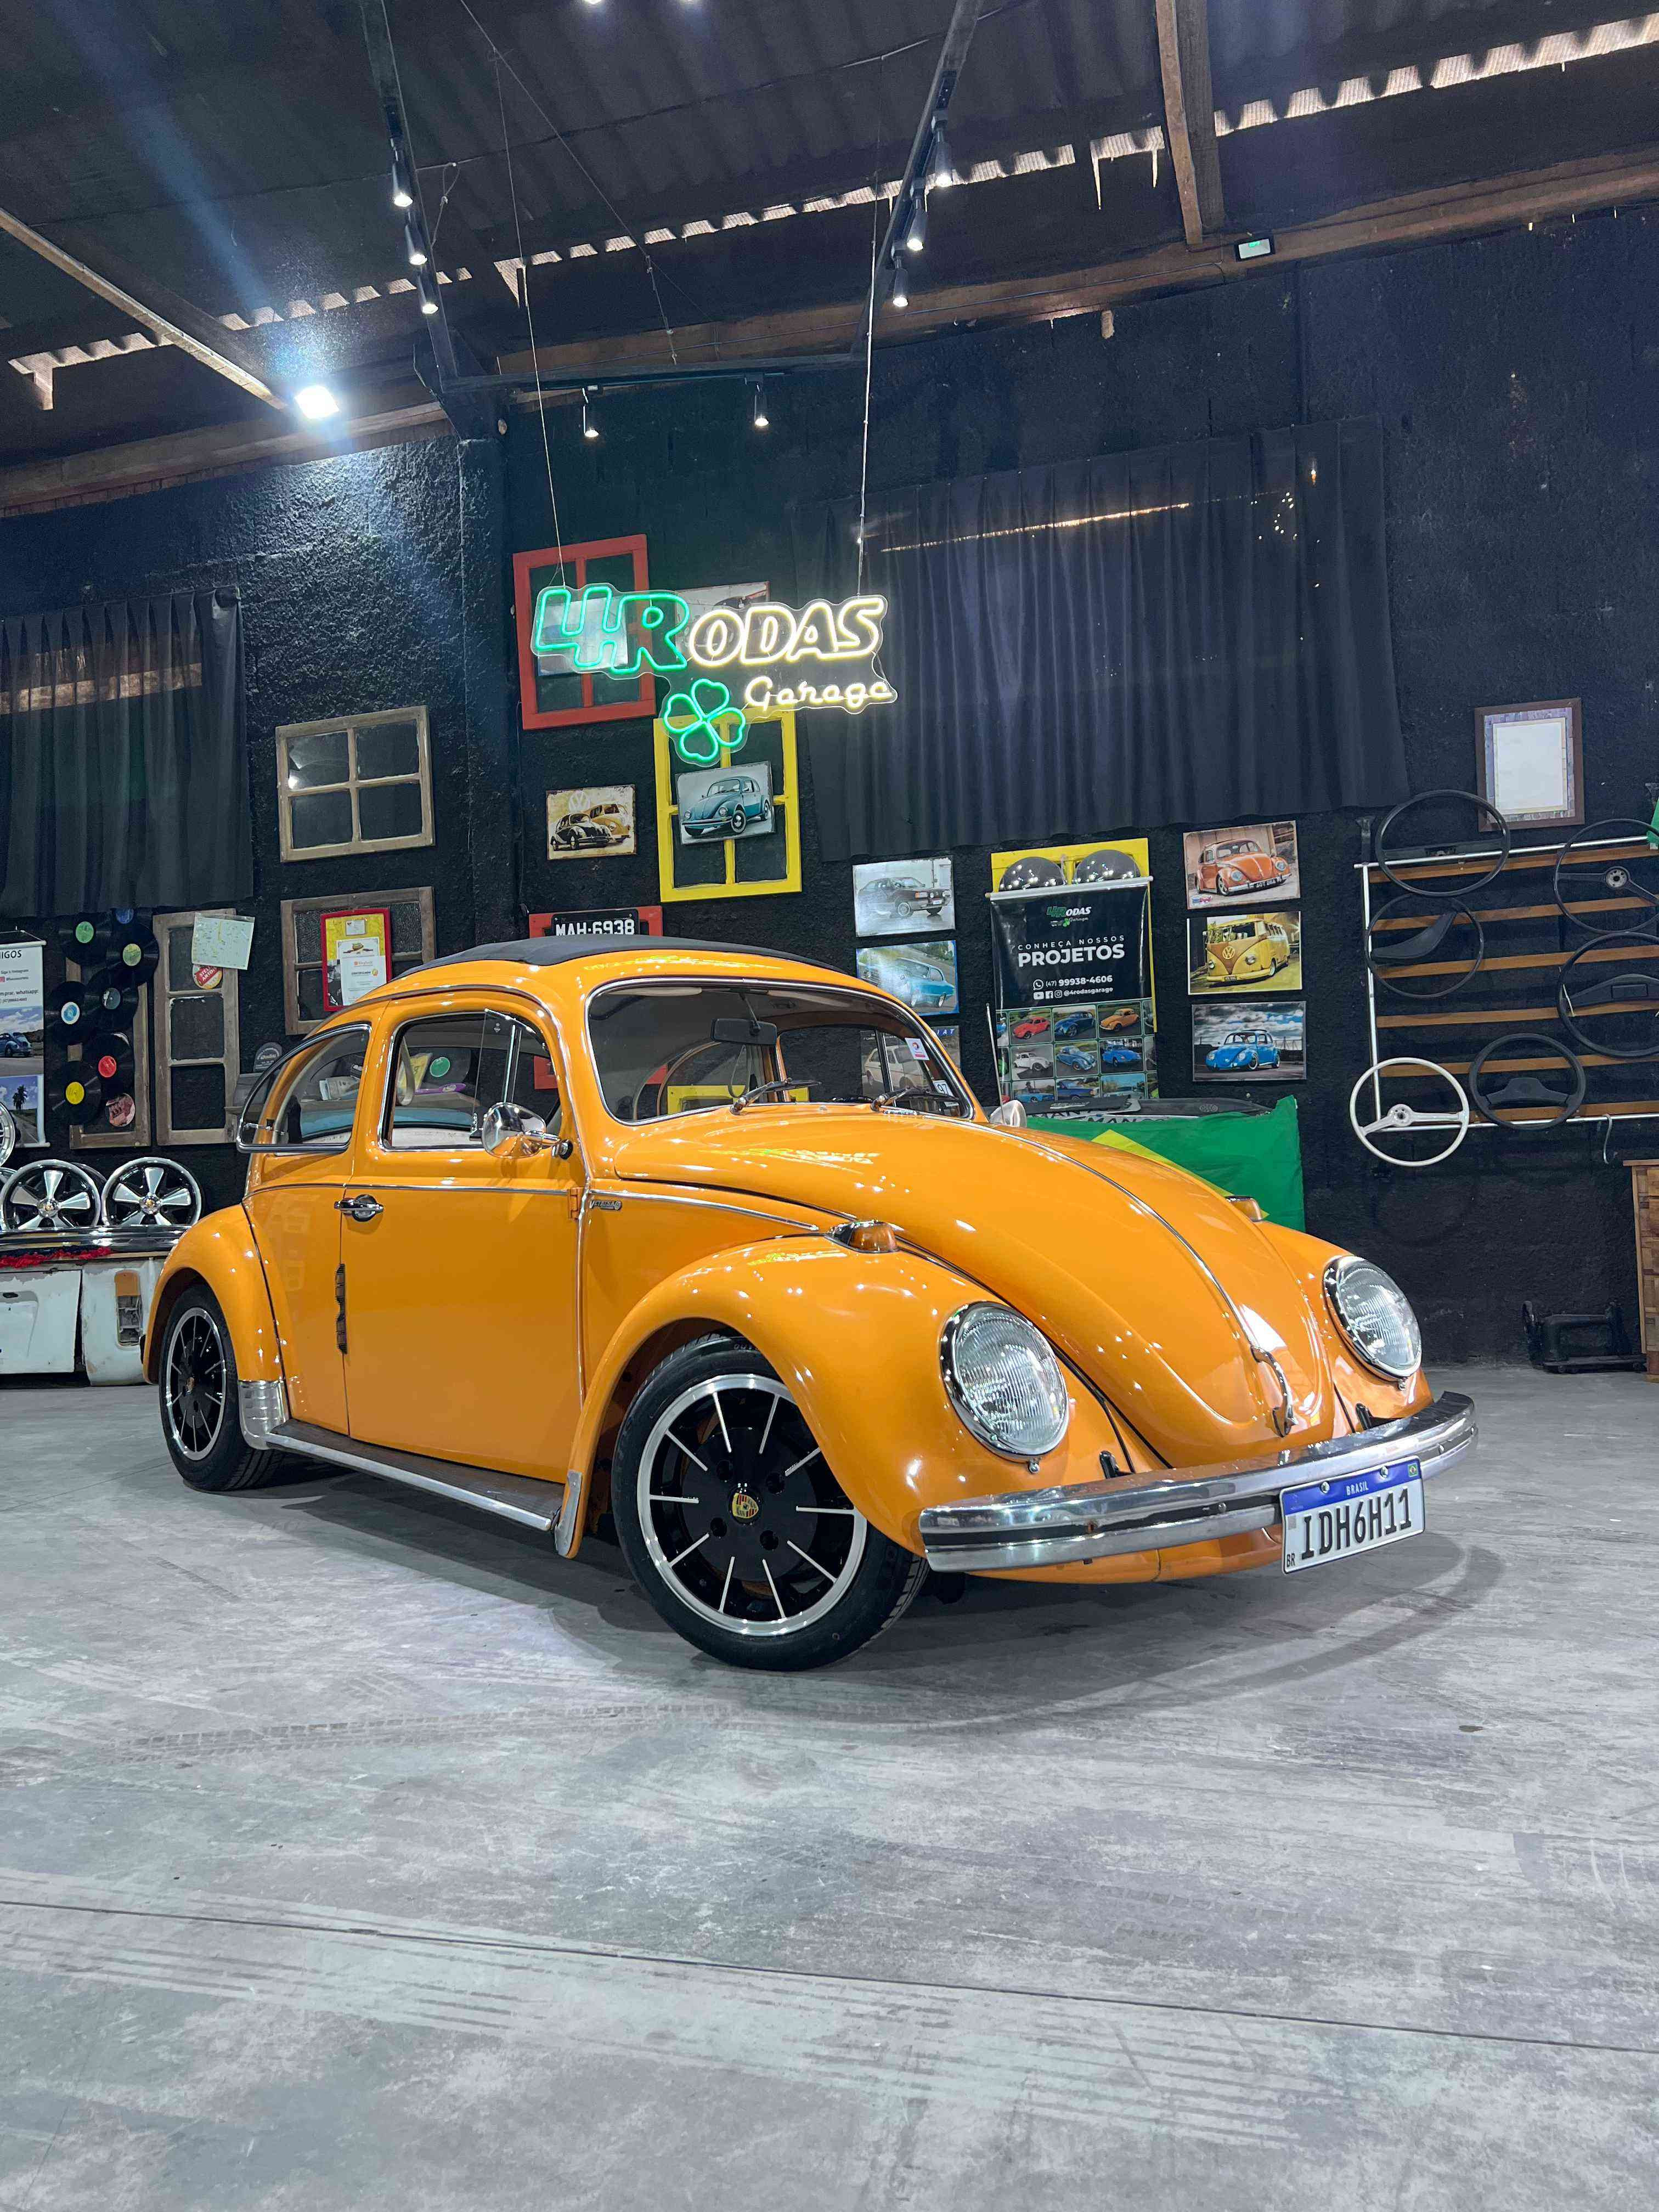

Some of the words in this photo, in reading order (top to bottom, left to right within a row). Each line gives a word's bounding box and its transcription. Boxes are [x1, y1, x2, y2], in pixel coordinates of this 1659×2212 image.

[744, 675, 893, 709] Garage
[1018, 940, 1071, 950] CONHEÇA
[1079, 935, 1125, 945] NOSSOS
[0, 950, 22, 959] IGOS
[1018, 943, 1125, 967] PROJETOS
[1058, 975, 1113, 986] 99938-4606
[1063, 987, 1114, 996] @4rodasgarage
[1346, 1481, 1369, 1496] BRASIL
[1301, 1487, 1412, 1560] IDH6H11
[1286, 1553, 1296, 1568] BR
